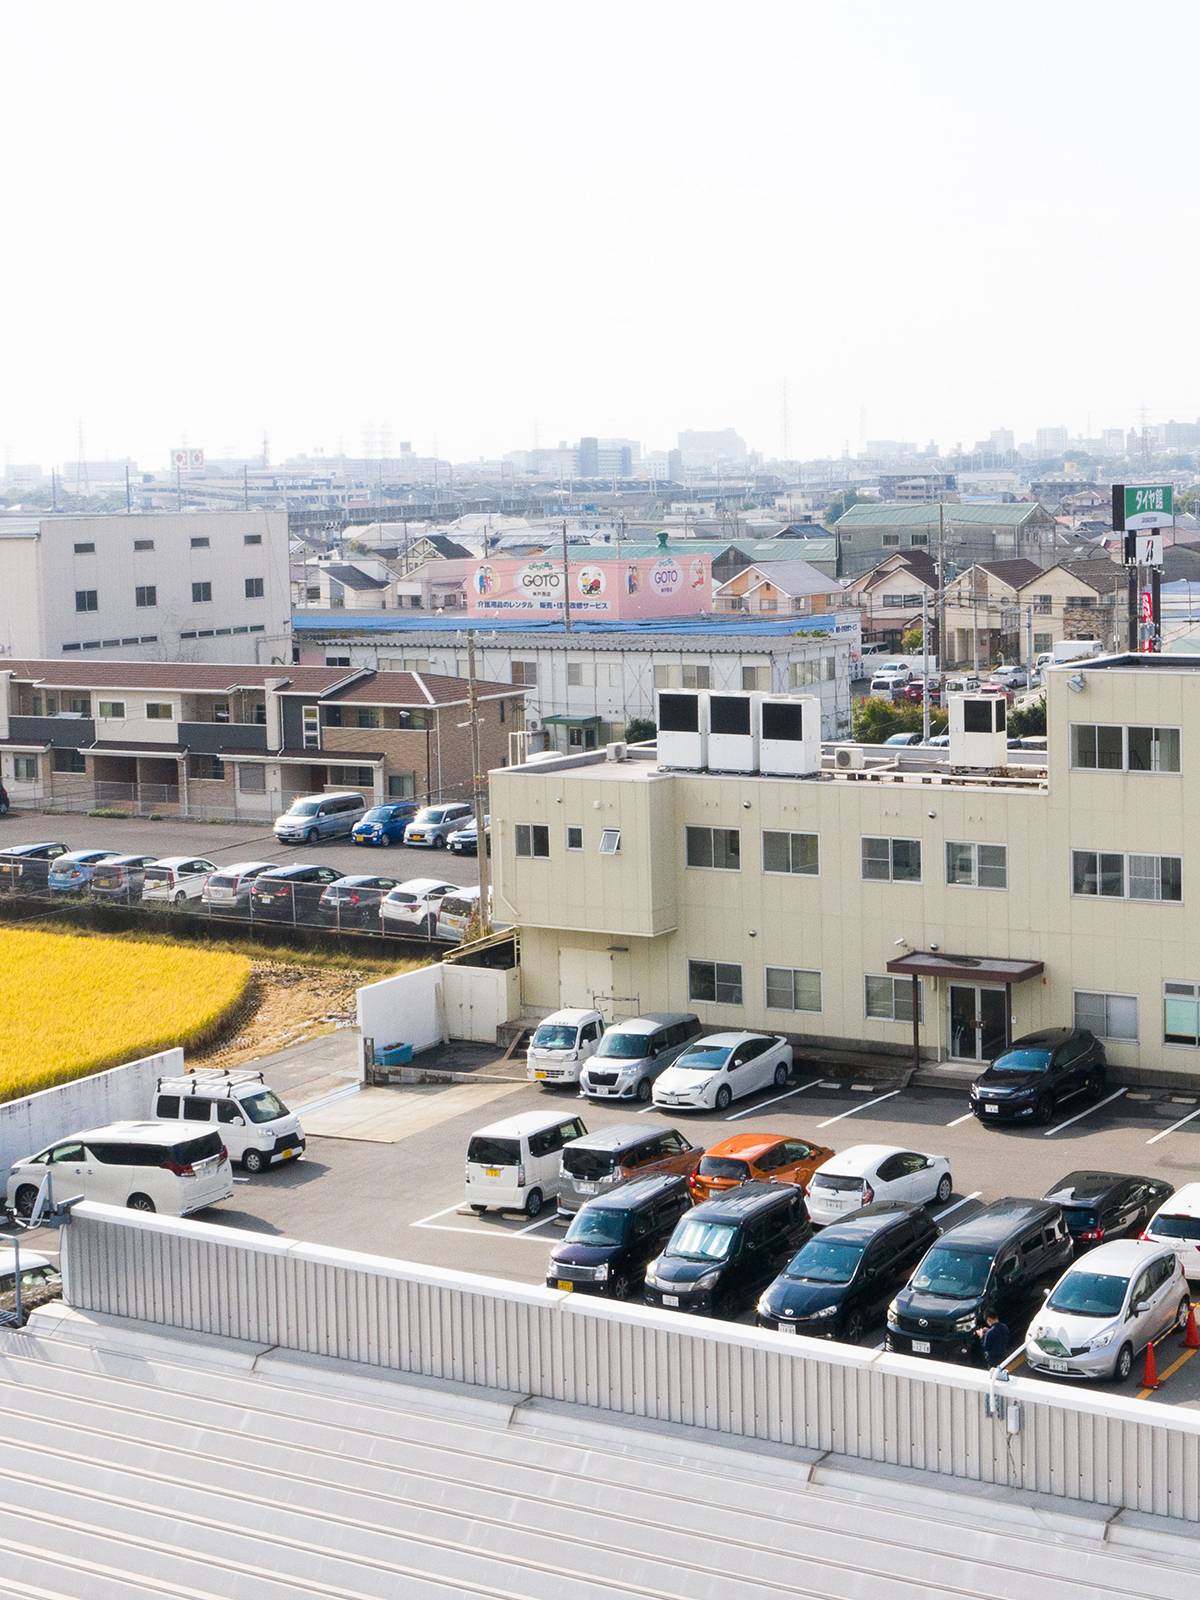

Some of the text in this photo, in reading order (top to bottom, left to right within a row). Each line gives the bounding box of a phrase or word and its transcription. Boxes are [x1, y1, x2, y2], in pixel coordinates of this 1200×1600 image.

[1136, 488, 1163, 510] タイヤ館
[522, 574, 560, 587] GOTO
[655, 570, 677, 584] GOTO
